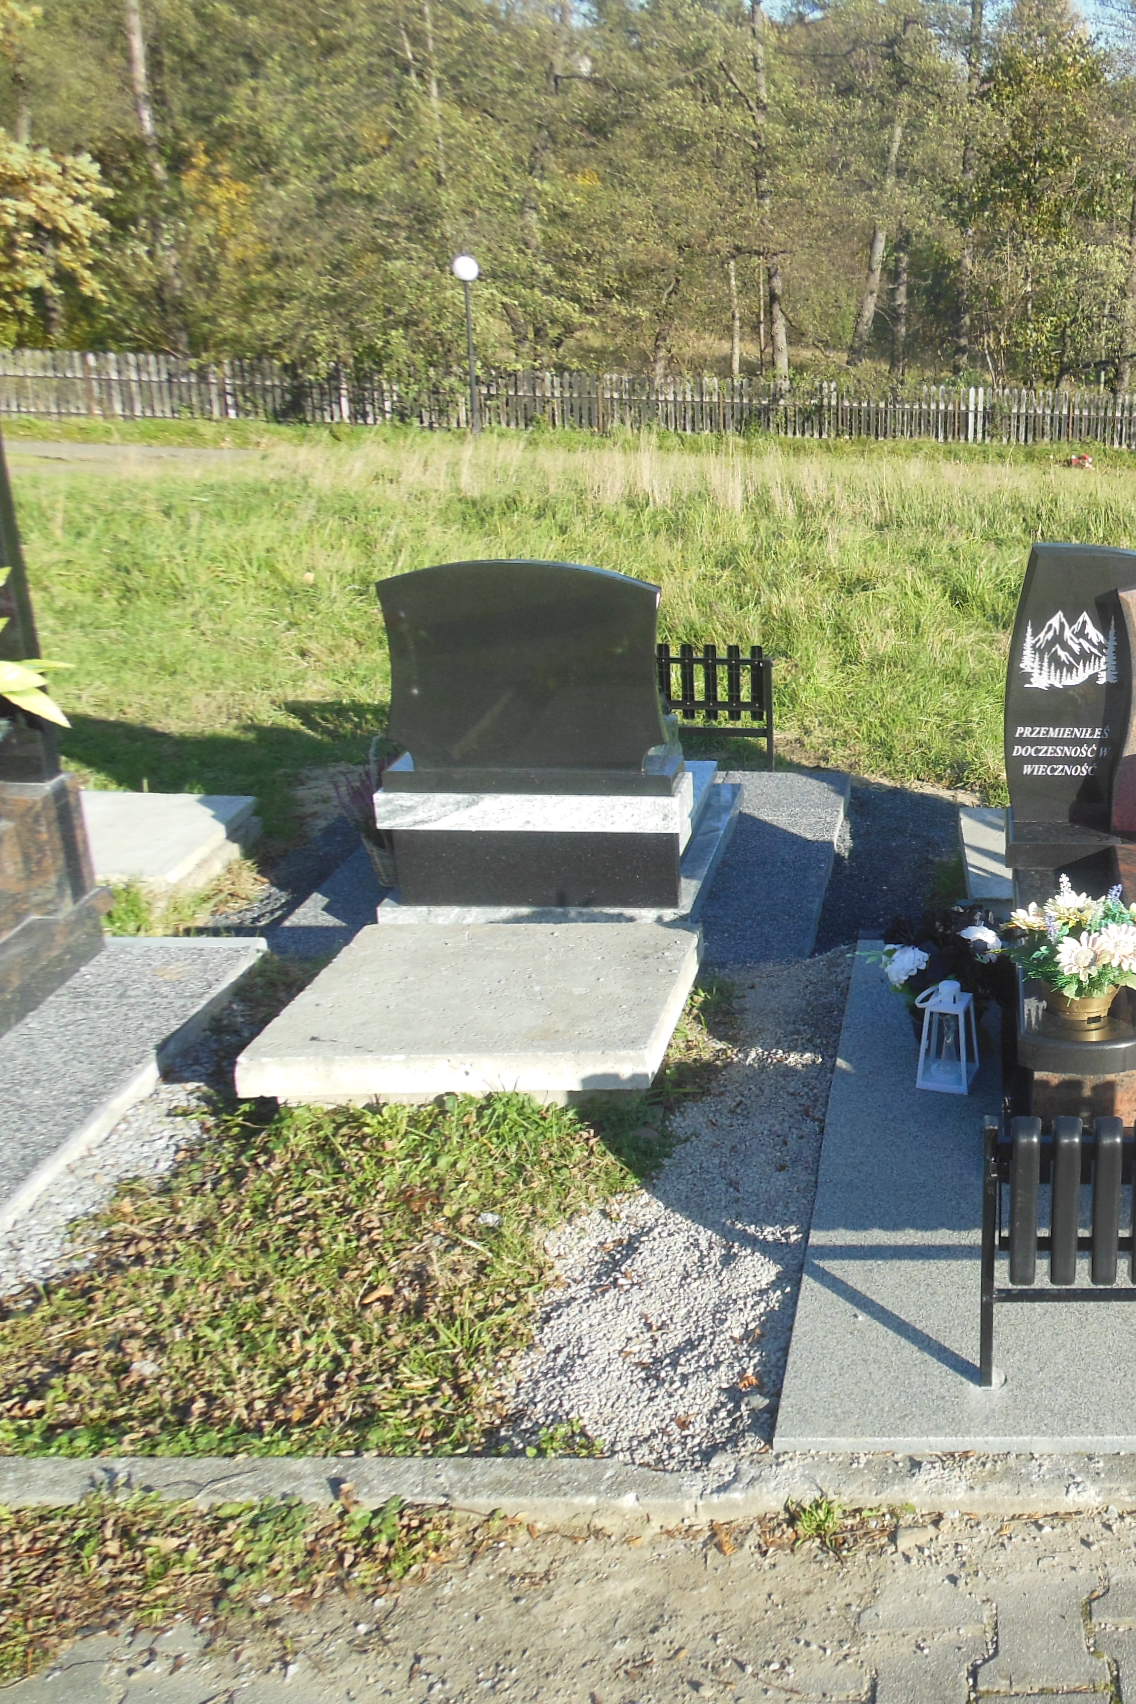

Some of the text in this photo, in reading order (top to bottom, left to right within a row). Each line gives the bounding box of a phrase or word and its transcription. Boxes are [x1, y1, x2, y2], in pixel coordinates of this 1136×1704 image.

[1014, 725, 1110, 739] PRZEMIENIŁEŚ
[1012, 744, 1097, 757] DOCZESNOŚĆ
[1023, 762, 1097, 776] WIECZNOŚĆ
